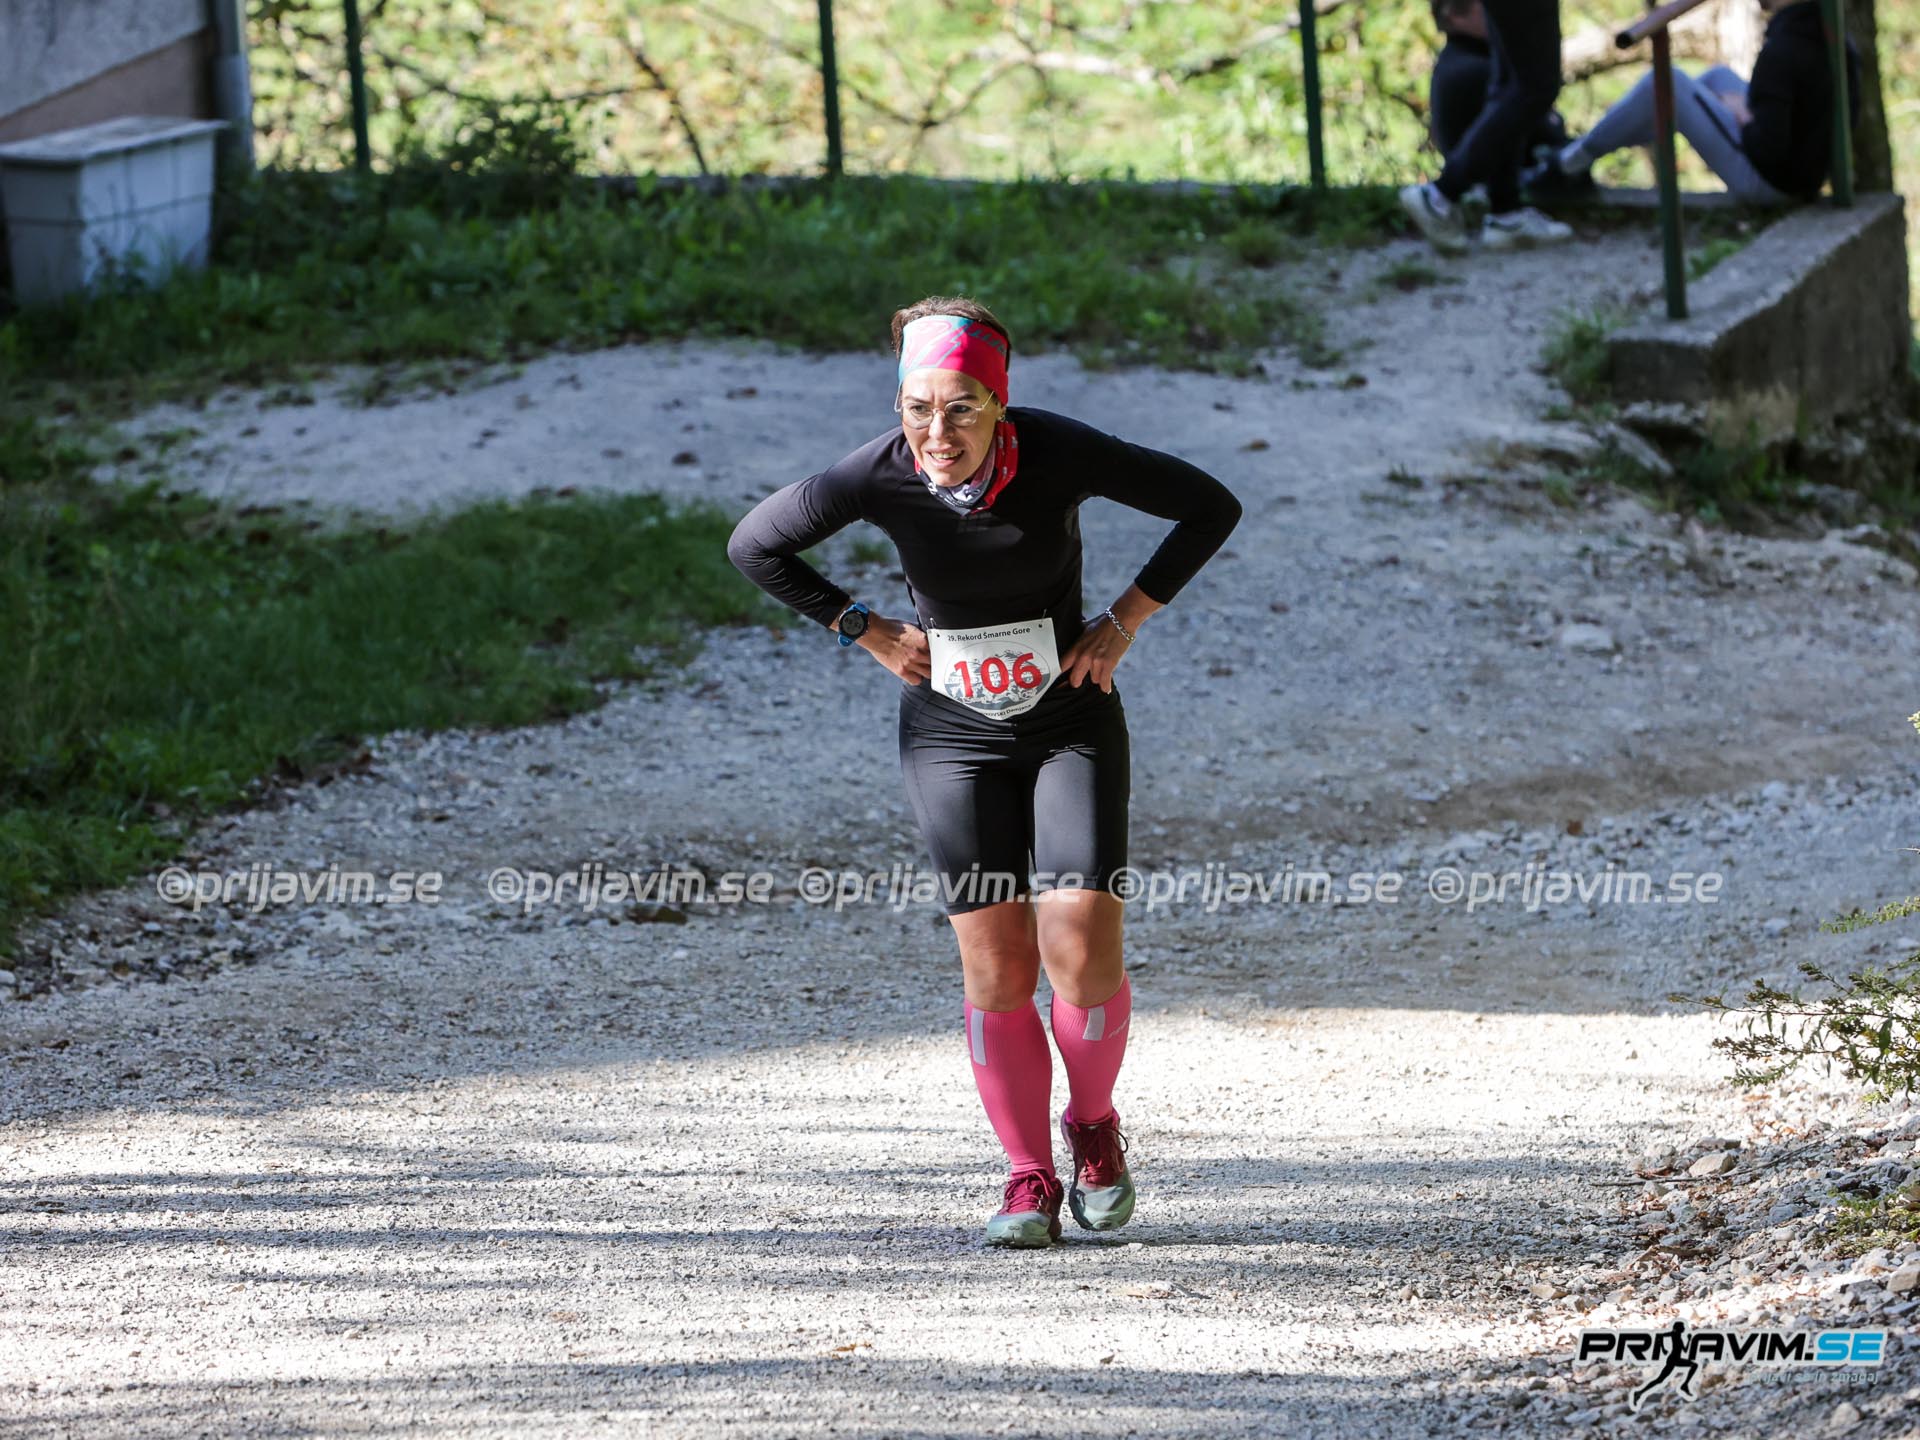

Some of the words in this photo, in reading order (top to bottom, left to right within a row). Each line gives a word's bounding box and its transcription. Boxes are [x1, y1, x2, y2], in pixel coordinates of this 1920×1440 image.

[958, 632, 982, 643] Rekord
[983, 629, 1011, 640] Šmarne
[1012, 626, 1031, 637] Gore
[954, 652, 1043, 698] 106
